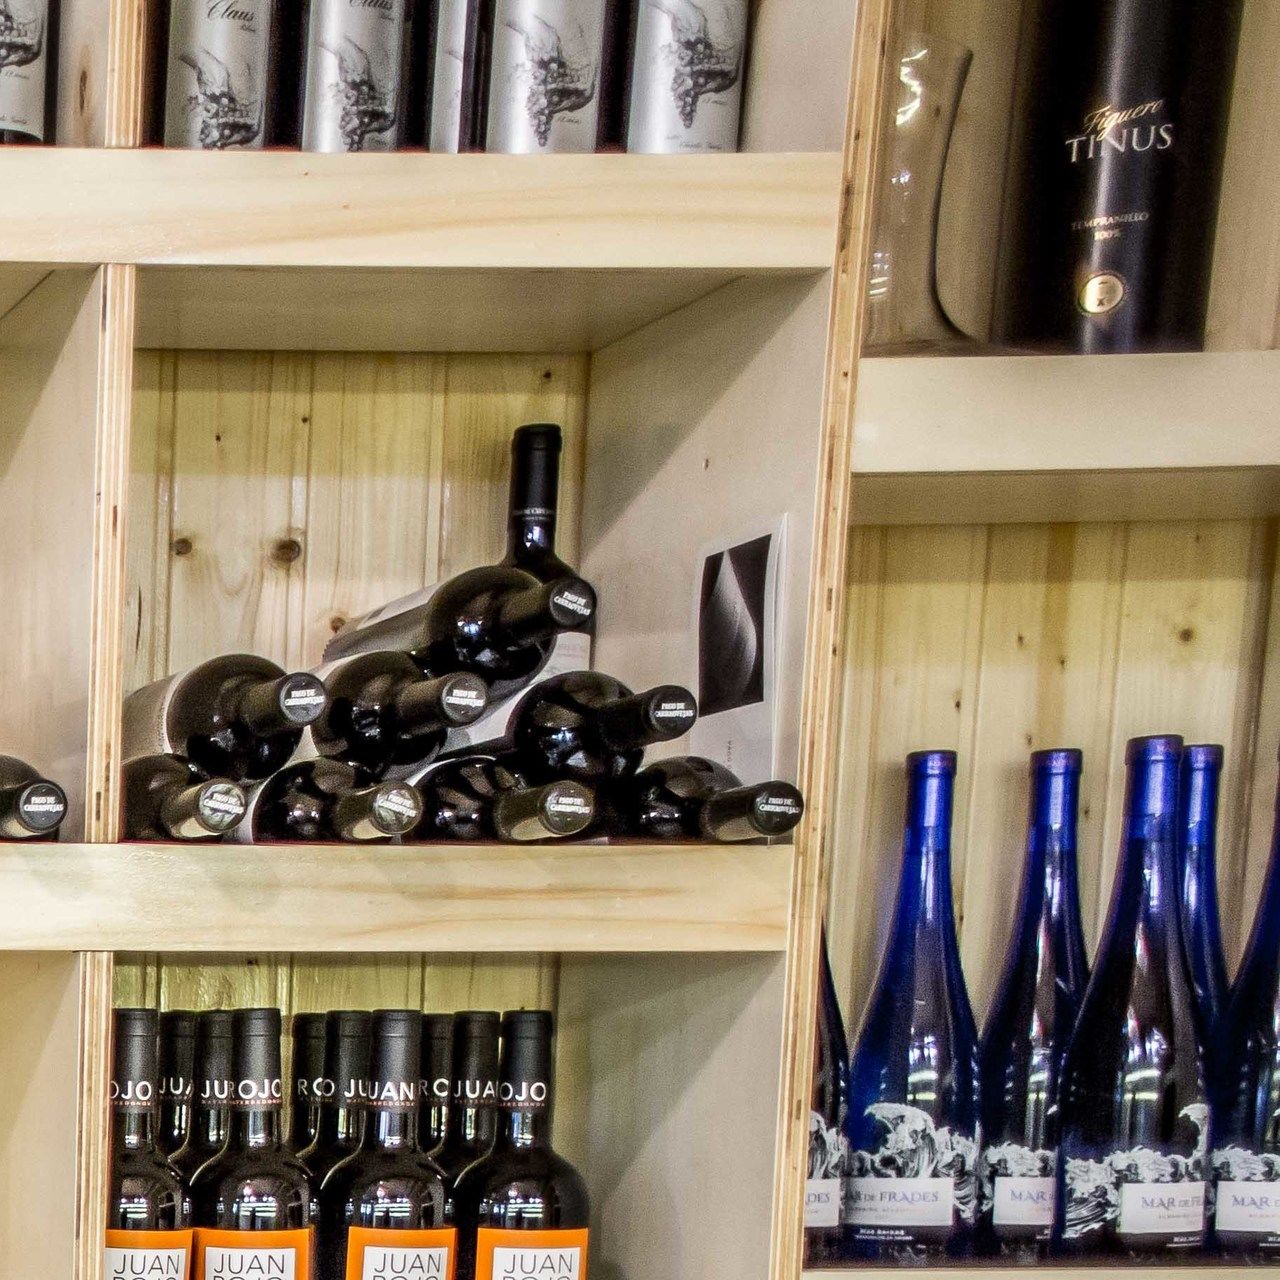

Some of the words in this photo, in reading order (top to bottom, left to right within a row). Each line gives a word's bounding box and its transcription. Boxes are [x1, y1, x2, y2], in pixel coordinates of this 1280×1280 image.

[1083, 100, 1163, 141] Figuero
[1066, 124, 1174, 163] TINUS
[201, 1080, 228, 1098] JU
[114, 1254, 180, 1275] JUAN
[213, 1254, 285, 1274] JUAN
[374, 1253, 441, 1274] JUAN
[504, 1253, 573, 1274] JUAN
